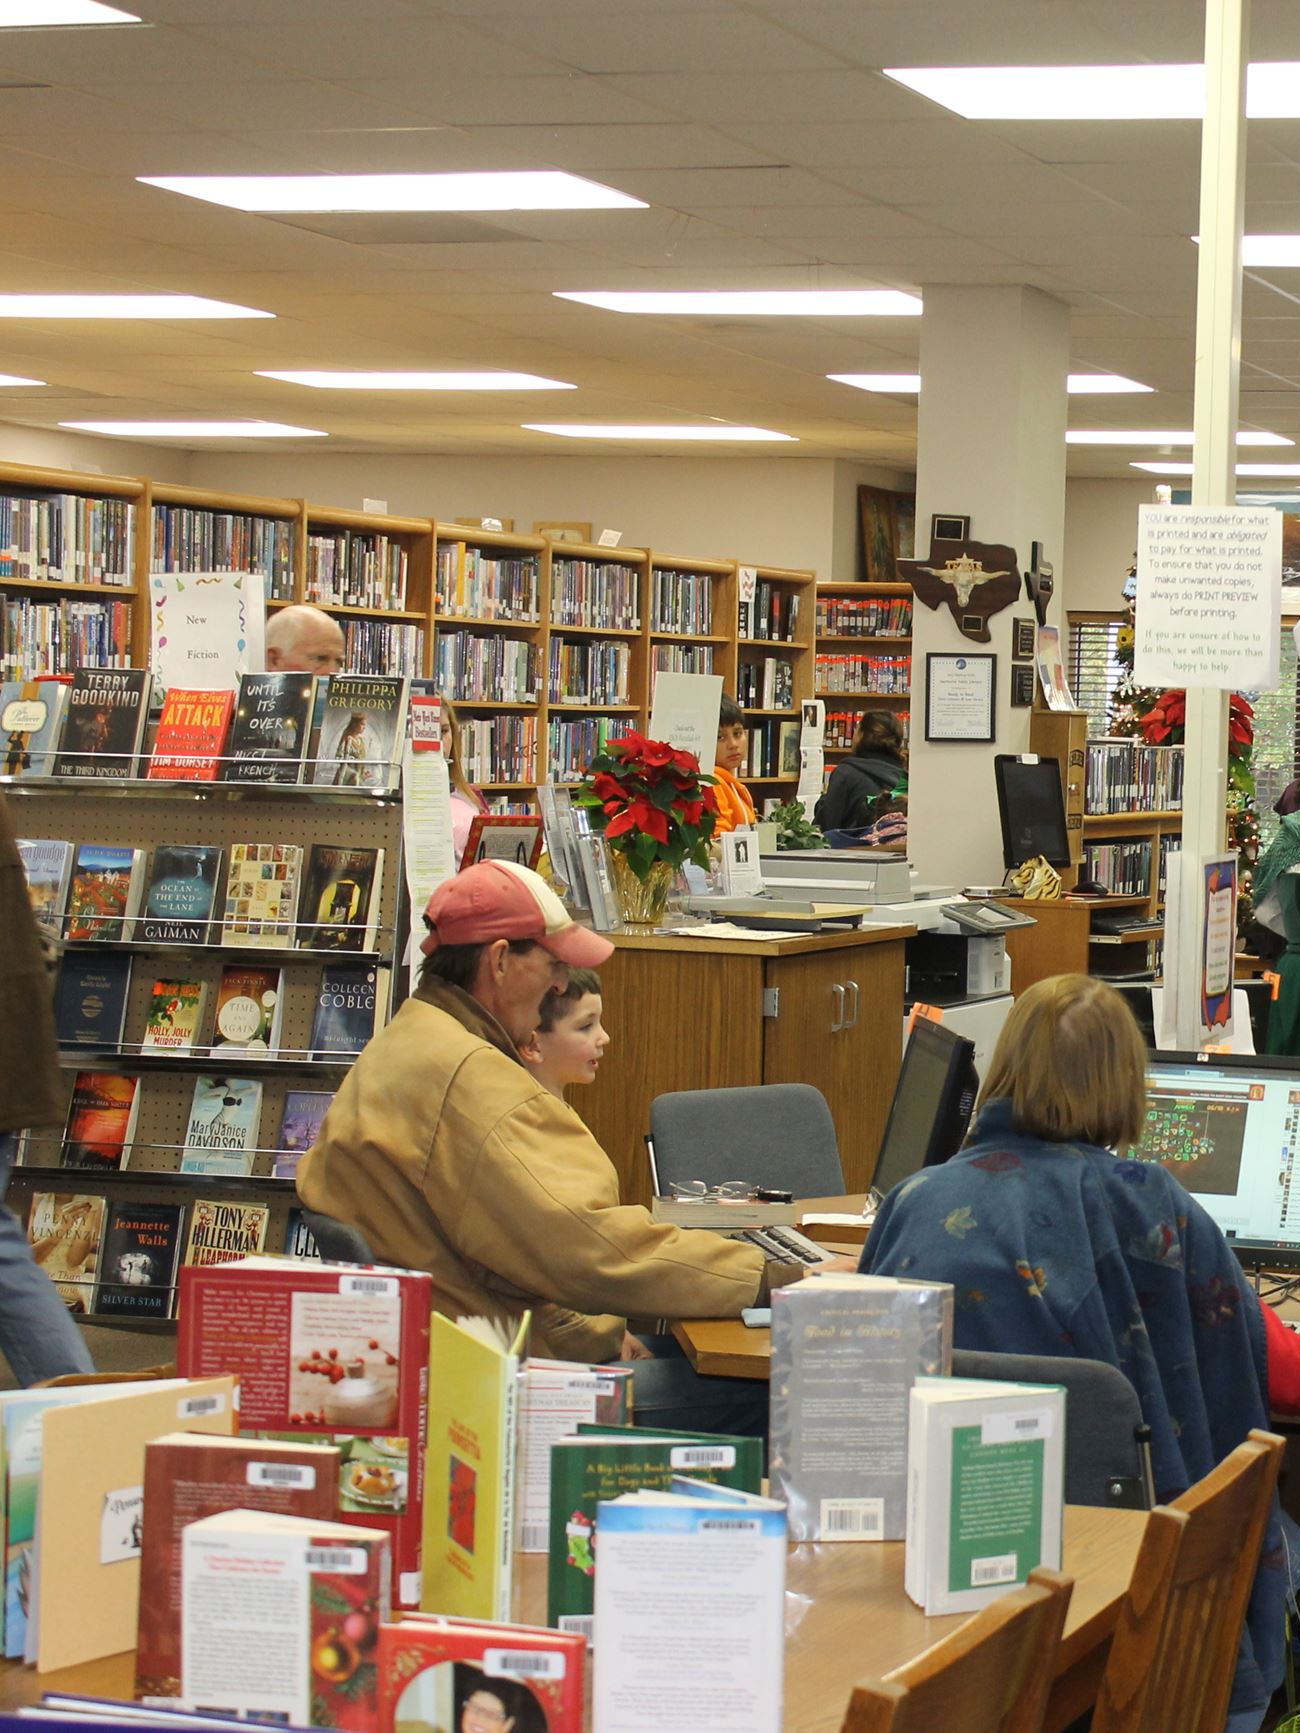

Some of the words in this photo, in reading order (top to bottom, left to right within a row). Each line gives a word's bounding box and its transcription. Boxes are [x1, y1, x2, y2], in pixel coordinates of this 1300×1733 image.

[1145, 513, 1161, 522] YOU
[1181, 514, 1230, 525] responsible
[1231, 515, 1245, 523] for
[1248, 516, 1269, 525] what
[1157, 529, 1189, 540] printed
[1192, 530, 1207, 539] and
[1209, 531, 1223, 539] are
[1226, 531, 1267, 542] obligated
[1149, 545, 1159, 553] to
[1161, 546, 1176, 556] pay
[1180, 544, 1192, 553] for
[1195, 545, 1216, 554] what
[1219, 546, 1226, 554] is
[1228, 546, 1263, 557] printed.
[1149, 559, 1159, 568] To
[1195, 561, 1212, 569] that
[1215, 562, 1231, 572] you
[1234, 561, 1244, 570] do
[1247, 563, 1263, 571] not
[1155, 575, 1177, 584] make
[1179, 576, 1222, 586] unwanted
[1224, 577, 1255, 588] copies,
[1150, 590, 1179, 601] always
[1181, 591, 1192, 600] do
[1194, 591, 1220, 600] PRINT
[1222, 592, 1259, 601] PREVIEW
[186, 614, 207, 625] New
[1170, 607, 1198, 616] before
[1200, 608, 1237, 620] printing.
[1145, 630, 1152, 638] If
[1155, 632, 1169, 641] you
[1189, 632, 1218, 640] unsure
[1221, 631, 1230, 640] of
[1233, 632, 1249, 641] how
[1253, 633, 1261, 641] to
[187, 649, 219, 660] Fiction
[1142, 645, 1152, 653] do
[1191, 646, 1204, 655] will
[1207, 646, 1217, 655] be
[1220, 648, 1241, 656] more
[1244, 648, 1263, 657] than
[1173, 661, 1197, 672] happy
[1200, 662, 1208, 671] to
[87, 674, 130, 690] TERRY
[246, 684, 284, 697] UNTIL
[331, 682, 397, 697] PHILIPPA
[71, 690, 139, 707] GOODKIND
[169, 691, 198, 703] When
[199, 691, 227, 703] Elves
[329, 697, 395, 711] GREGORY
[163, 704, 224, 727] ATTACK
[249, 717, 283, 730] OVER
[60, 765, 72, 775] THE
[75, 766, 95, 776] THIRD
[96, 766, 128, 777] KINGDOM
[238, 764, 277, 776] FRENCH
[169, 903, 194, 911] LANE
[145, 926, 200, 940] GAIMAN
[322, 982, 375, 994] COLLEEN
[229, 1002, 254, 1013] TIME
[319, 994, 375, 1009] COBLE
[148, 1025, 171, 1036] HOLLY,
[172, 1026, 192, 1038] JOLLY
[222, 1024, 255, 1033] AGAIN
[154, 1036, 183, 1046] MURDER
[188, 1135, 244, 1149] DAVIDSON
[43, 1213, 87, 1226] PENNY
[214, 1205, 246, 1229] TONY
[114, 1218, 170, 1232] Jeannette
[31, 1228, 99, 1241] VINCENZI
[137, 1234, 168, 1246] Walls
[192, 1225, 260, 1253] HILLERMAN
[58, 1271, 81, 1281] Than
[101, 1294, 136, 1304] SILVER
[138, 1297, 161, 1307] STAR
[586, 1464, 595, 1473] A
[597, 1463, 613, 1474] Big
[615, 1463, 641, 1473] Little
[644, 1462, 665, 1473] Book
[601, 1476, 615, 1486] for
[618, 1477, 639, 1488] Dogs
[642, 1476, 659, 1485] and
